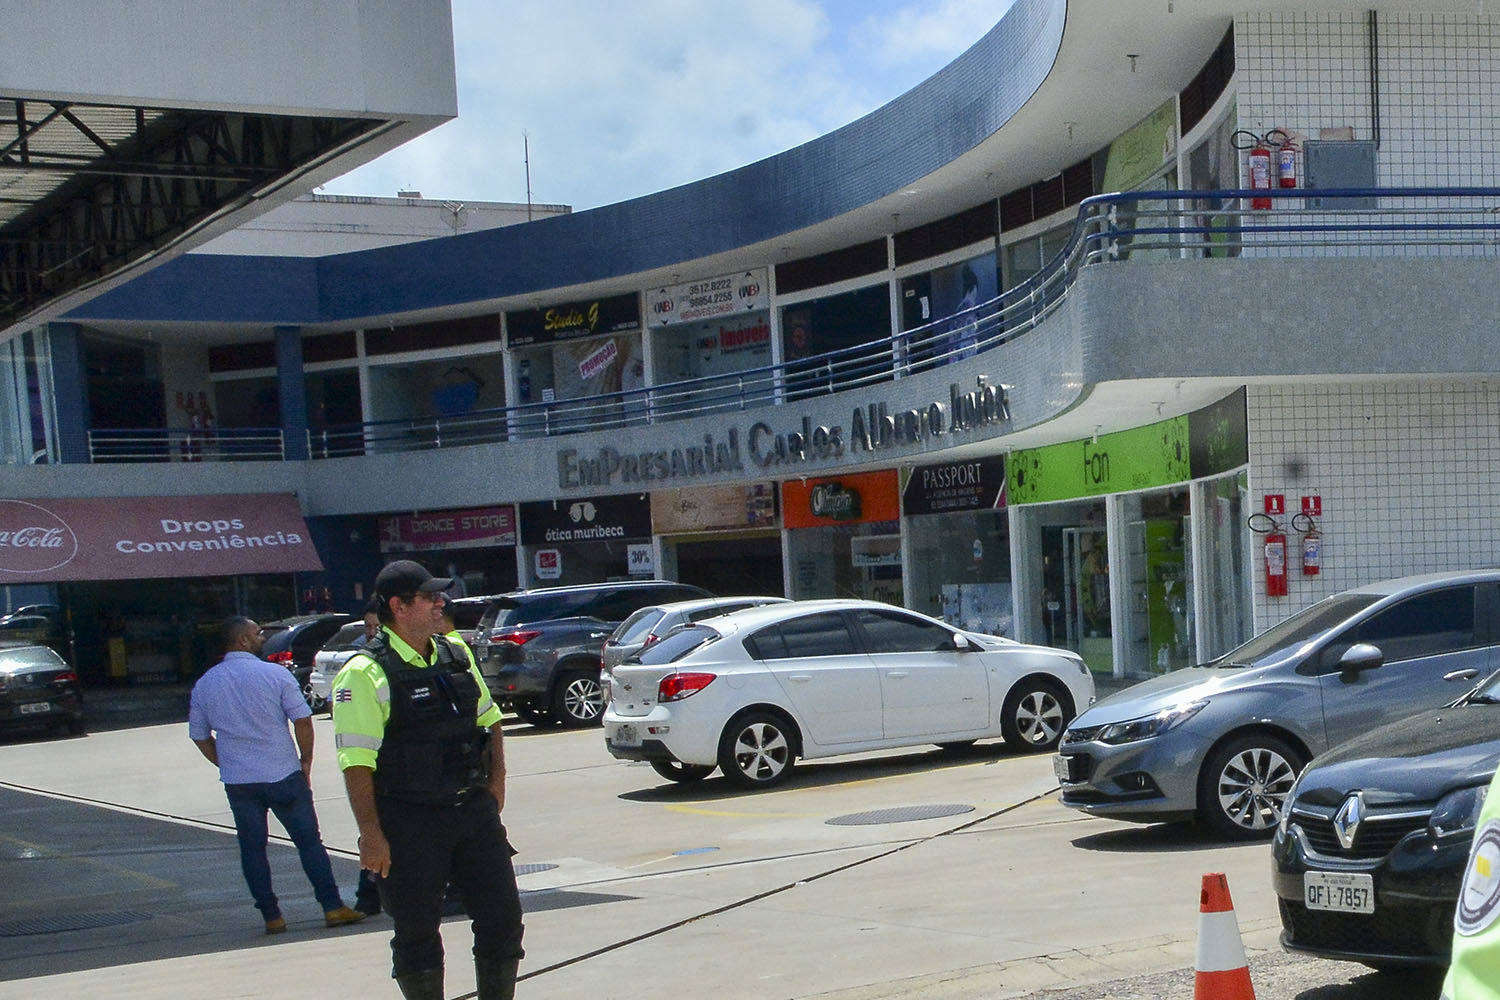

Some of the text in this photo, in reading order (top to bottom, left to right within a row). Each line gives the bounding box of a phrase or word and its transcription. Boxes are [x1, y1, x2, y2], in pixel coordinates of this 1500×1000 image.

[544, 310, 583, 331] Studio
[1083, 439, 1111, 485] Fan
[922, 463, 983, 490] PASSPORT
[160, 517, 245, 535] Drops
[411, 513, 509, 533] DANCE STORE
[545, 525, 625, 541] ótica muribeca
[115, 530, 303, 554] Conveniência
